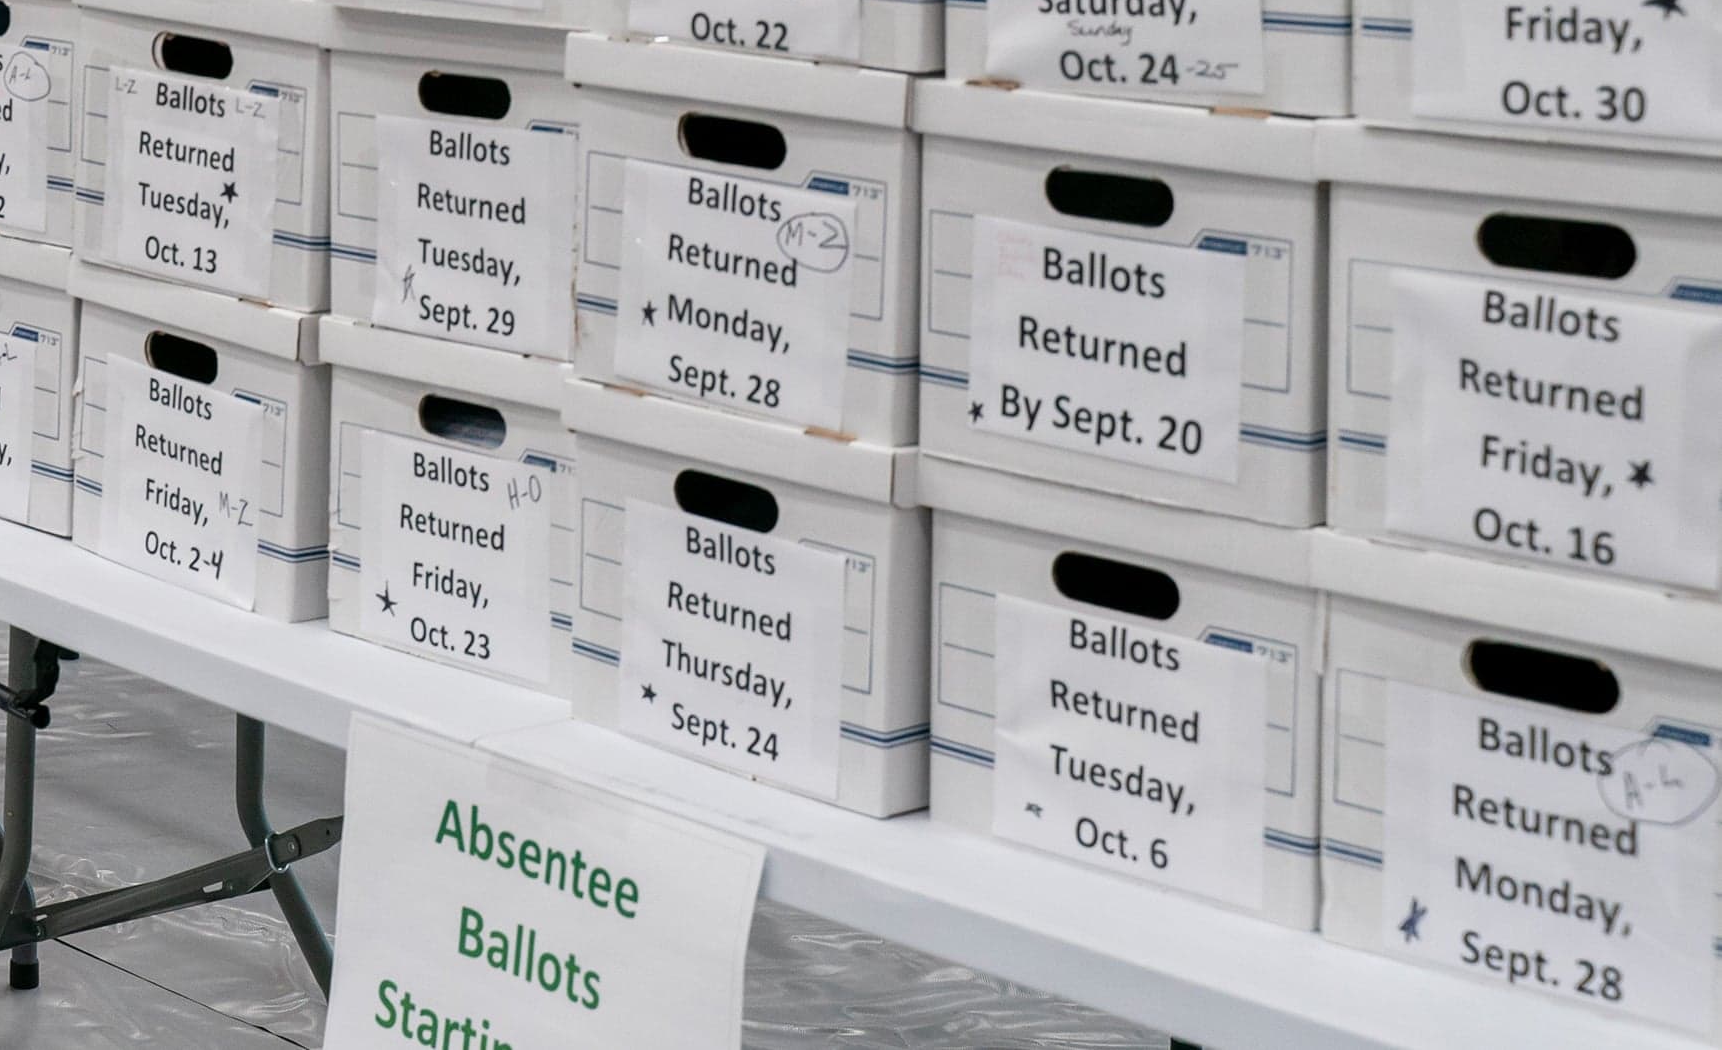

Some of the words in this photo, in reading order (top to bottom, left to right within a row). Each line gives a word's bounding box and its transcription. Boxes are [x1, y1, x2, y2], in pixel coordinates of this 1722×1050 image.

[691, 12, 745, 47] Oct.
[756, 20, 788, 52] 22
[1506, 6, 1641, 54] Friday,
[1060, 50, 1126, 83] Oct.
[1139, 53, 1179, 85] 24
[156, 82, 224, 117] Ballots
[1502, 81, 1580, 118] Oct.
[1598, 86, 1645, 122] 30
[139, 131, 234, 172] Returned
[430, 130, 510, 165] Ballots
[138, 182, 229, 229] Tuesday,
[418, 183, 525, 224] Returned
[689, 176, 781, 222] Ballots
[146, 236, 184, 266] Oct.
[193, 247, 216, 273] 13
[418, 238, 520, 286] Tuesday,
[668, 233, 798, 287] Returned
[1044, 247, 1165, 298] Ballots
[420, 295, 477, 331] Sept.
[487, 308, 514, 336] 29
[669, 294, 789, 353] Monday,
[1483, 290, 1619, 342] Ballots
[1020, 316, 1186, 377] Returned
[150, 378, 211, 419] Ballots
[669, 355, 735, 398] Sept.
[747, 375, 780, 408] 28
[1460, 358, 1643, 421] Returned
[1002, 384, 1041, 430] By
[1053, 395, 1142, 445] Sept.
[1158, 416, 1202, 454] 20
[136, 424, 222, 476] Returned
[414, 452, 489, 492] Ballots
[1482, 435, 1612, 497] Friday,
[146, 478, 207, 526] Friday,
[401, 504, 504, 551] Returned
[146, 531, 181, 565] Oct.
[189, 547, 223, 579] 2-4
[687, 527, 775, 575] Ballots
[1474, 508, 1550, 554] Oct.
[1569, 527, 1615, 566] 16
[414, 562, 488, 608] Friday,
[668, 581, 791, 641] Returned
[411, 617, 454, 651] Oct.
[464, 630, 490, 659] 23
[1071, 619, 1179, 670] Ballots
[662, 639, 791, 709] Thursday,
[672, 703, 736, 748] Sept.
[747, 727, 778, 761] 24
[1051, 680, 1199, 743] Returned
[1479, 718, 1614, 776] Ballots
[1050, 745, 1194, 815] Tuesday,
[1076, 817, 1137, 861] Oct.
[1150, 839, 1168, 869] 6
[1454, 784, 1638, 857] Returned
[435, 800, 639, 918] Absentee
[1456, 857, 1630, 946] Monday,
[458, 907, 601, 1010] Ballots
[1462, 931, 1558, 986] Sept.
[1576, 960, 1622, 1001] 28
